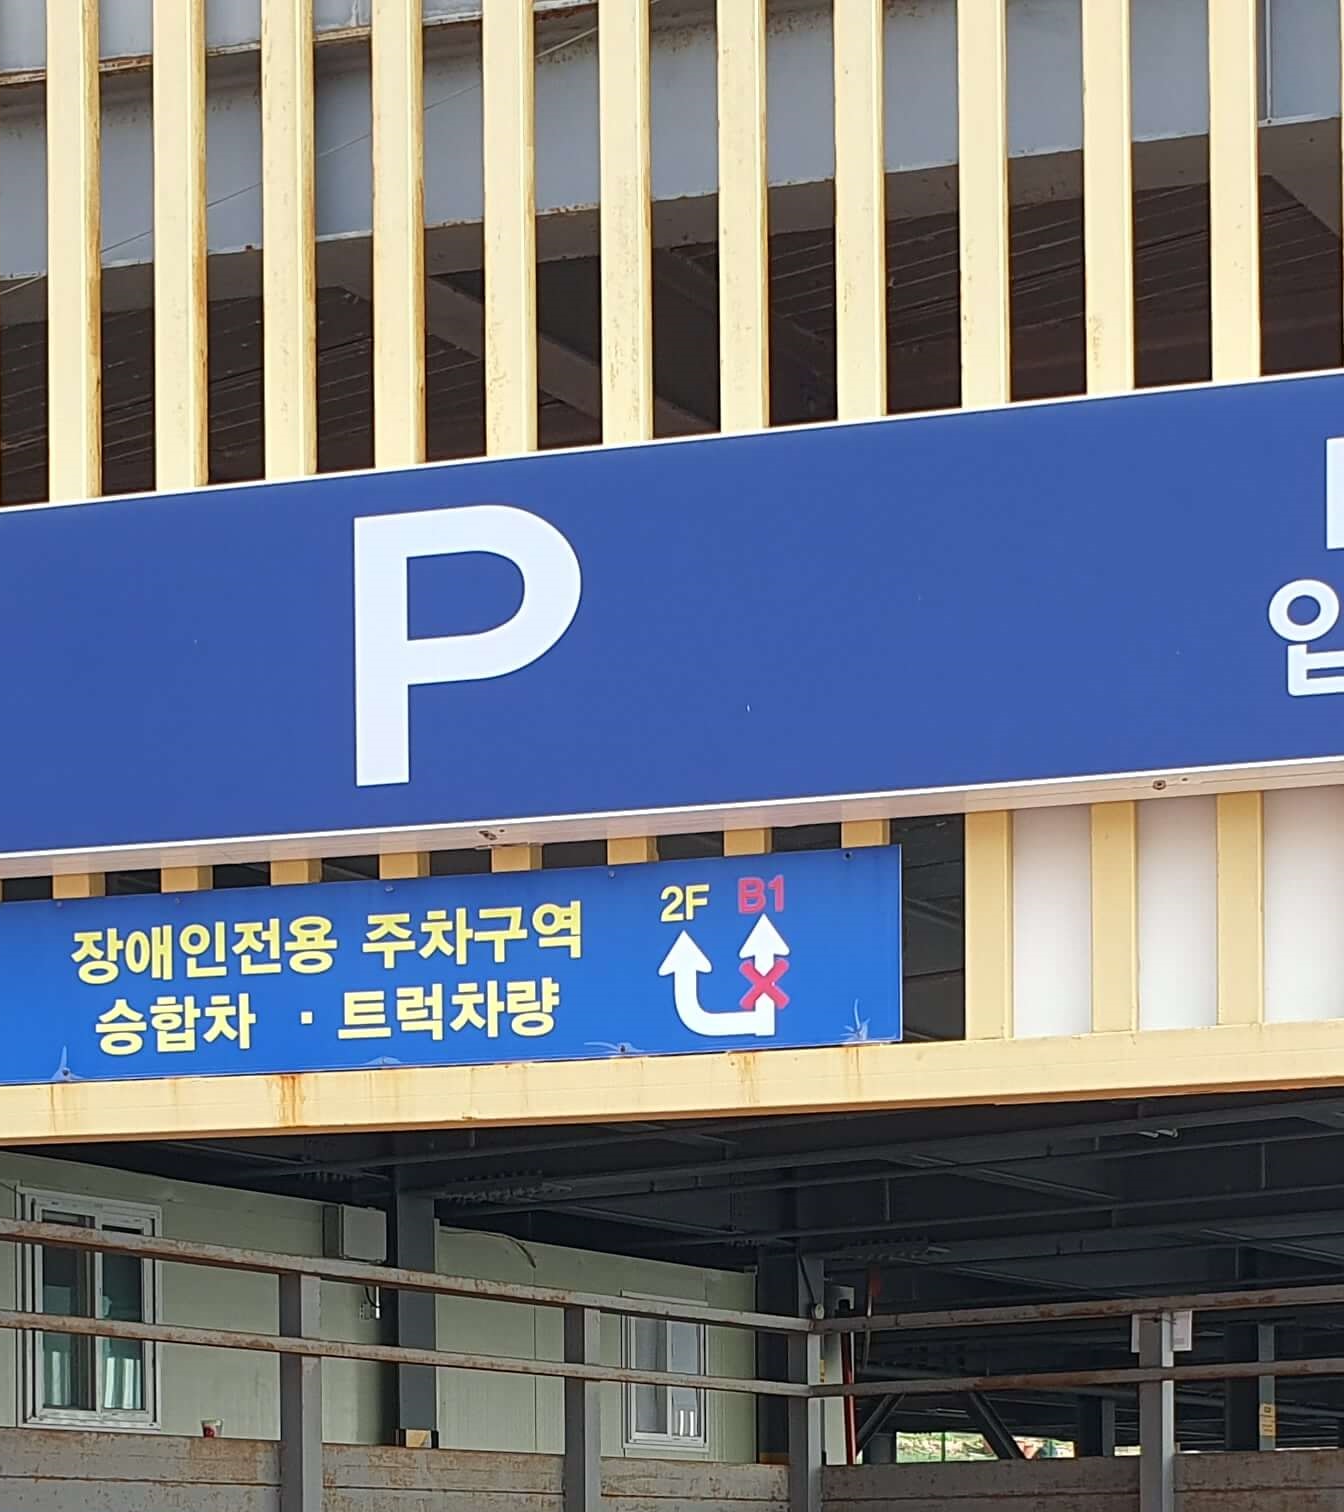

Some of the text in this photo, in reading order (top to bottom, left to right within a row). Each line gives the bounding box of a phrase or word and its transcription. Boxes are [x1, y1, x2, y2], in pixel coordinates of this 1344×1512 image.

[353, 504, 582, 788] P
[659, 884, 710, 924] 2F
[737, 875, 786, 914] B1
[70, 899, 584, 986] 장애인전용 주차구역
[94, 994, 257, 1057] 승합차
[336, 976, 561, 1044] 트럭차량
